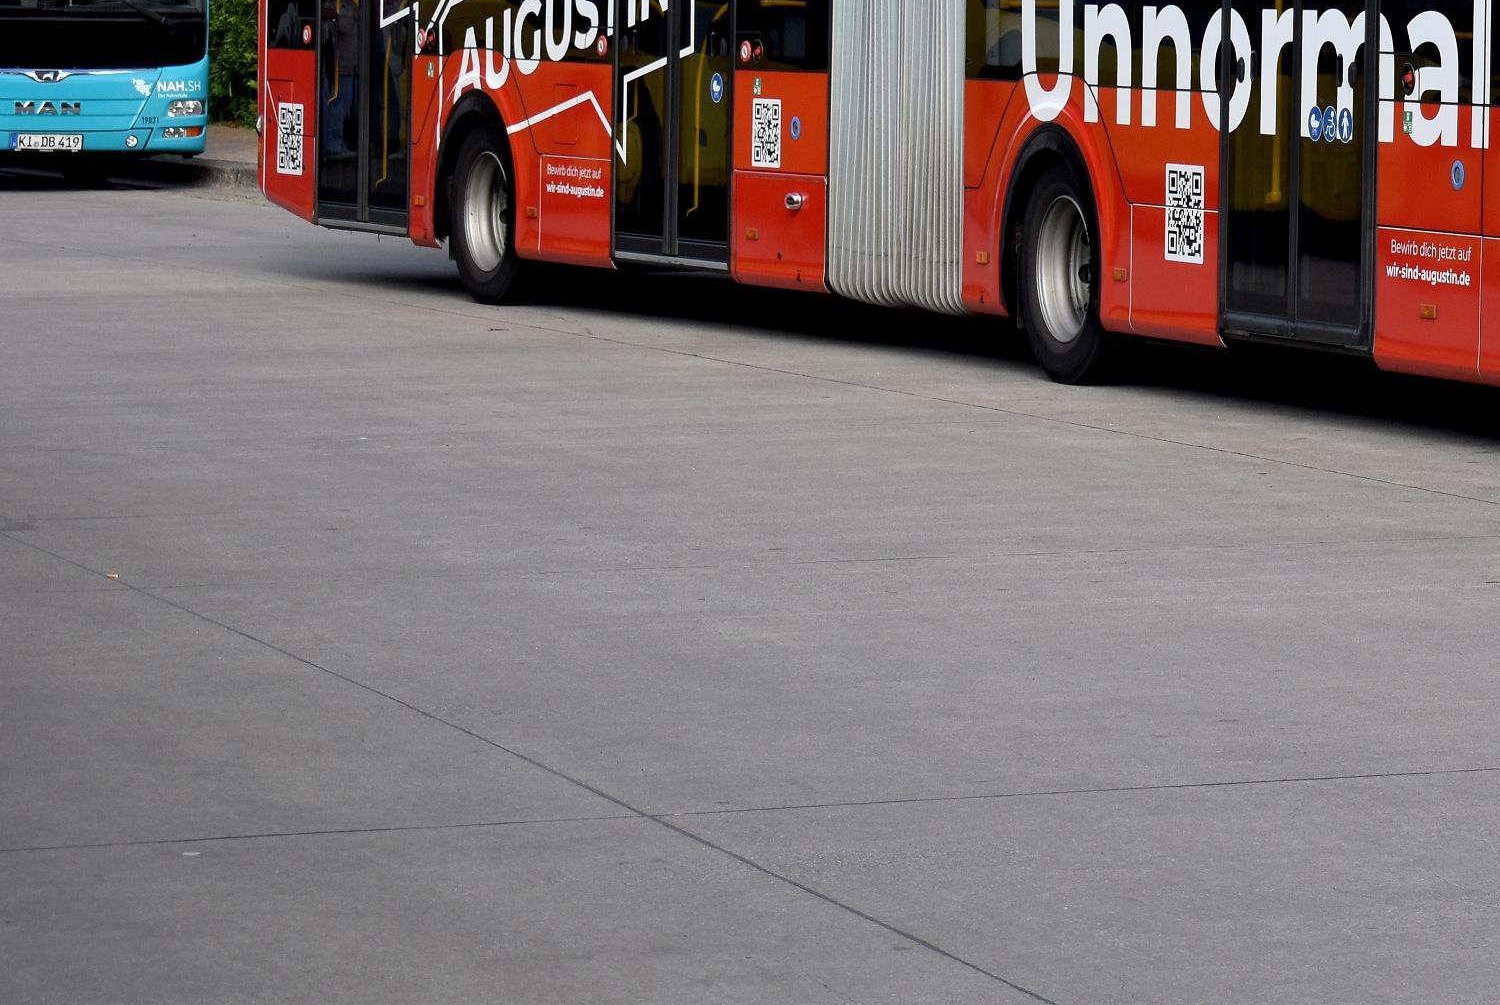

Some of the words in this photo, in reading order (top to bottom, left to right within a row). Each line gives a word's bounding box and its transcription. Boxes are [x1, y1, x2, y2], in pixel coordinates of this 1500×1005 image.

[156, 80, 200, 92] NAH.SH
[14, 101, 81, 116] MAN
[19, 136, 32, 148] KI
[41, 136, 56, 148] DB
[58, 136, 80, 148] 419
[546, 164, 566, 176] Bewirb
[566, 165, 578, 177] dich
[578, 166, 591, 180] jetzt
[592, 168, 602, 179] auf
[546, 180, 604, 198] wir-sind-augustin.de
[1390, 239, 1418, 256] Bewirb
[1420, 242, 1436, 258] dich
[1437, 244, 1456, 262] jetzt
[1458, 246, 1472, 262] auf
[1386, 262, 1471, 286] wir-sind-augustin.de
